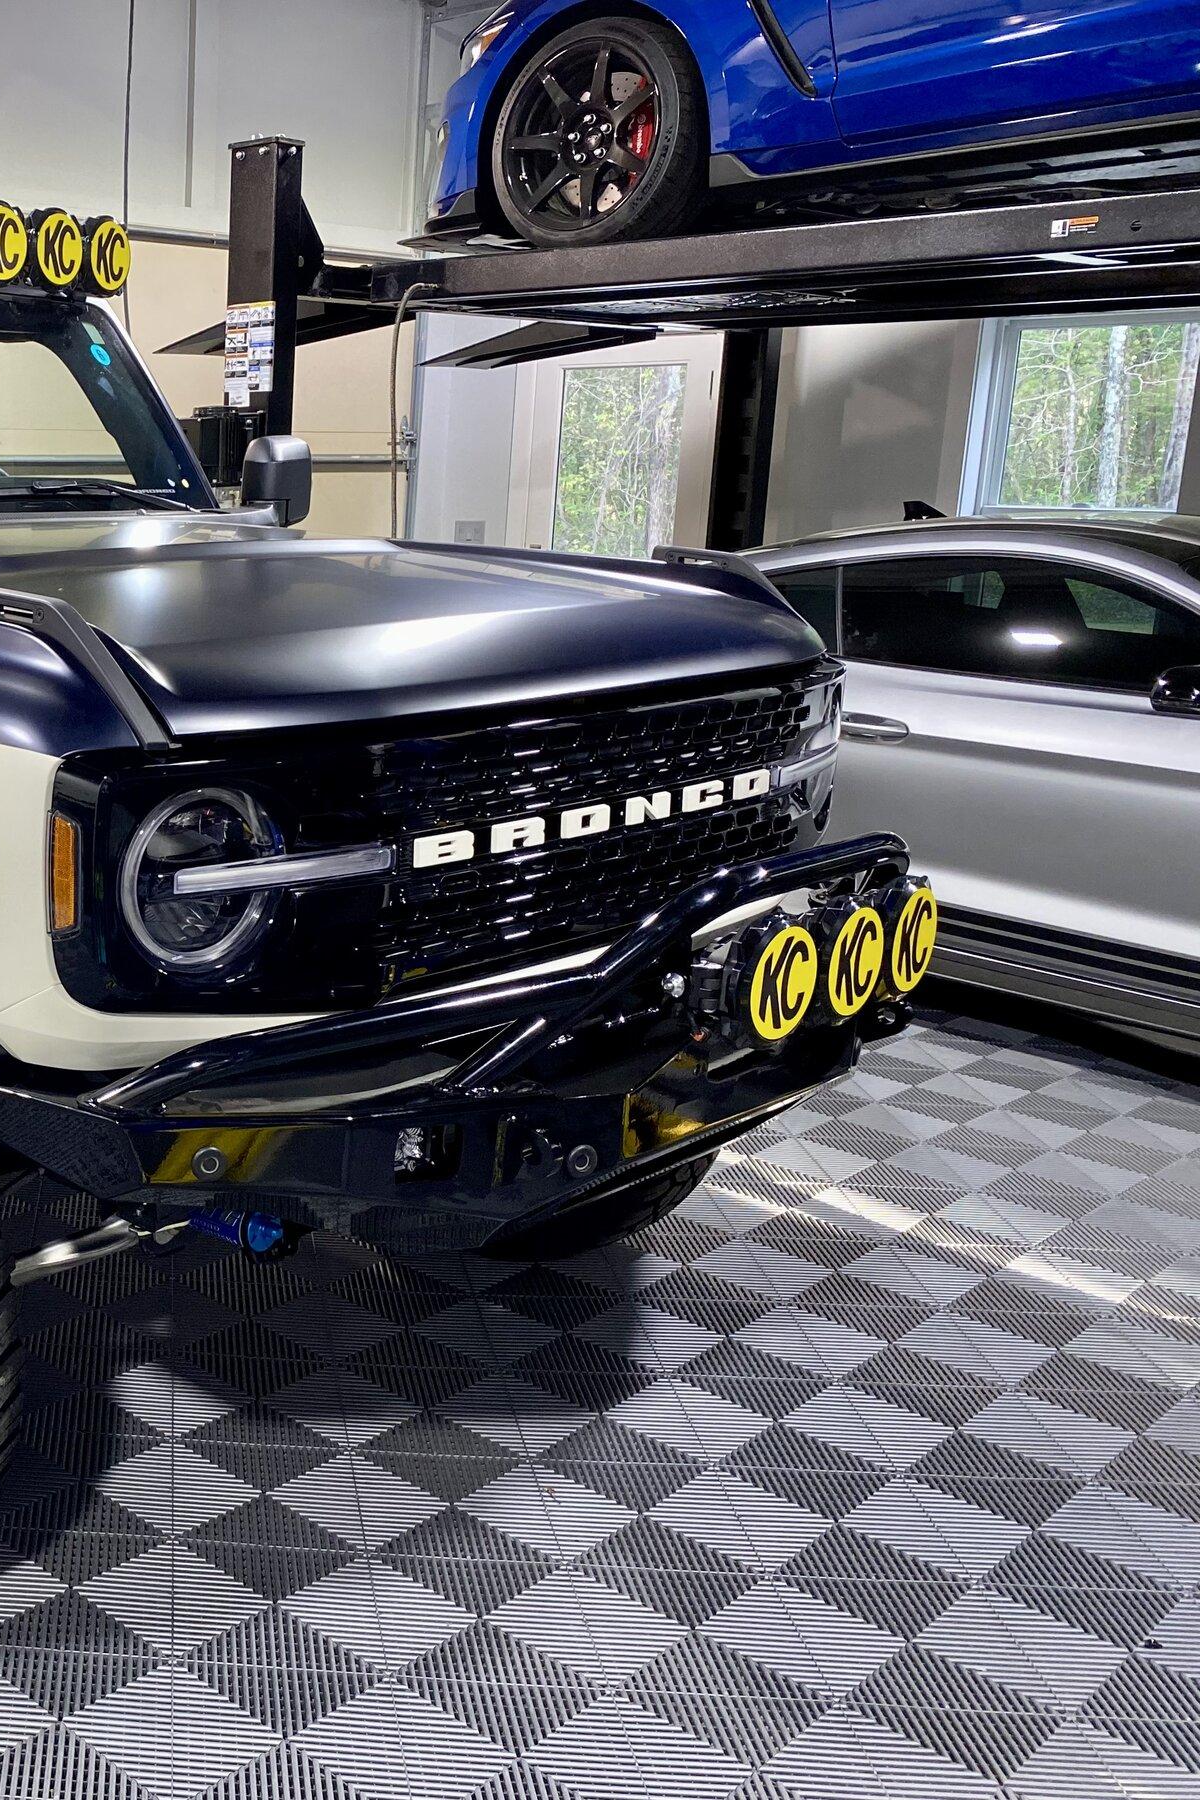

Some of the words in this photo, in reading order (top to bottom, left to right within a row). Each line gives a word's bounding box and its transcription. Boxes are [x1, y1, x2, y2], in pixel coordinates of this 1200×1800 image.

[44, 220, 75, 278] KC
[96, 228, 125, 283] KC
[412, 769, 771, 868] BRONCO
[758, 935, 809, 1029] KC
[835, 916, 877, 1006] KC
[897, 896, 932, 982] KC
